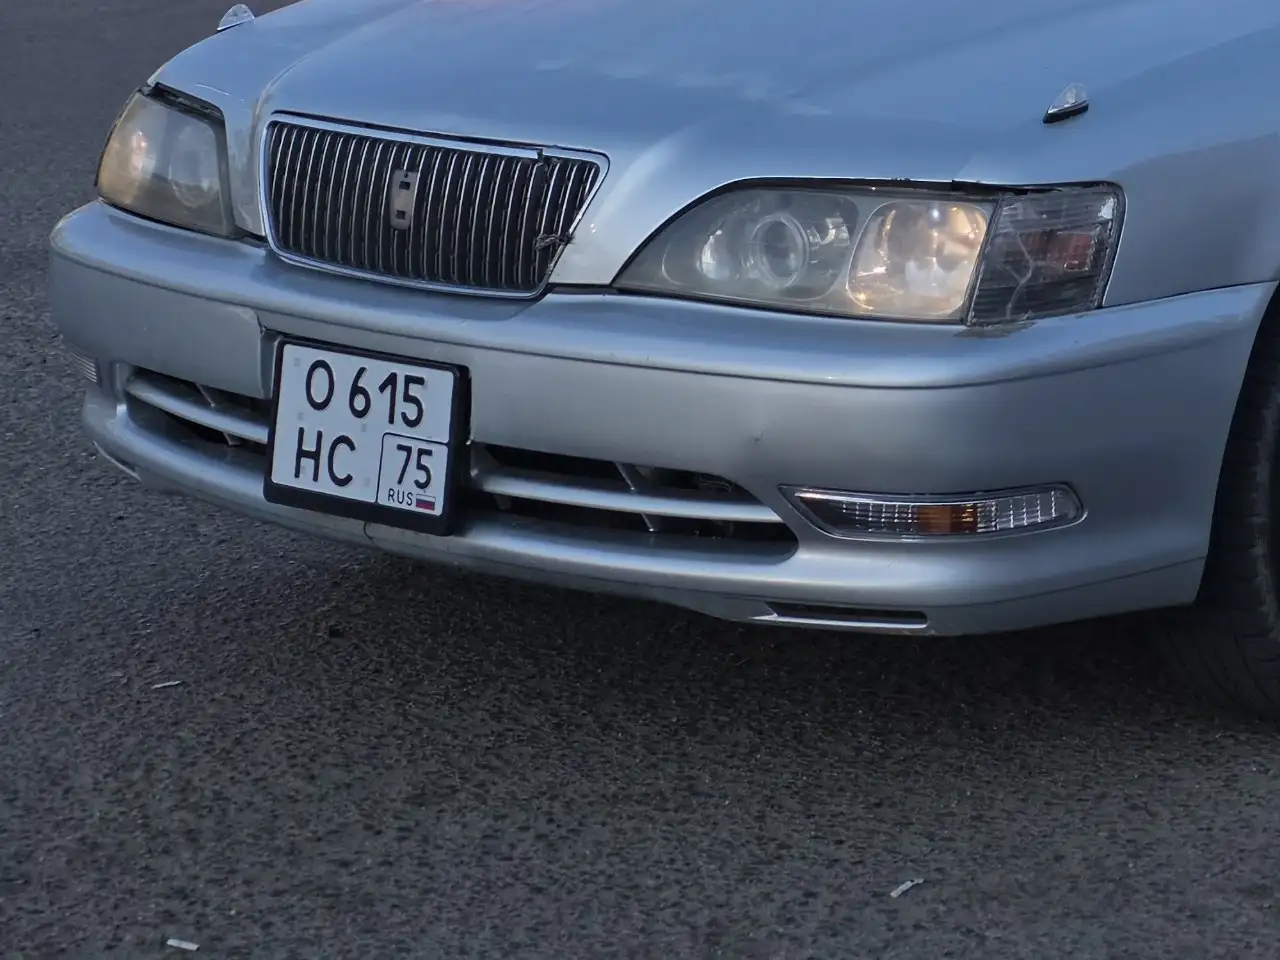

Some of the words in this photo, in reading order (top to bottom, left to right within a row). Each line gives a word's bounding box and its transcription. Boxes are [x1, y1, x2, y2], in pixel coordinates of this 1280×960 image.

[348, 366, 426, 428] 615
[396, 443, 433, 490] 75
[387, 488, 413, 507] RUS
